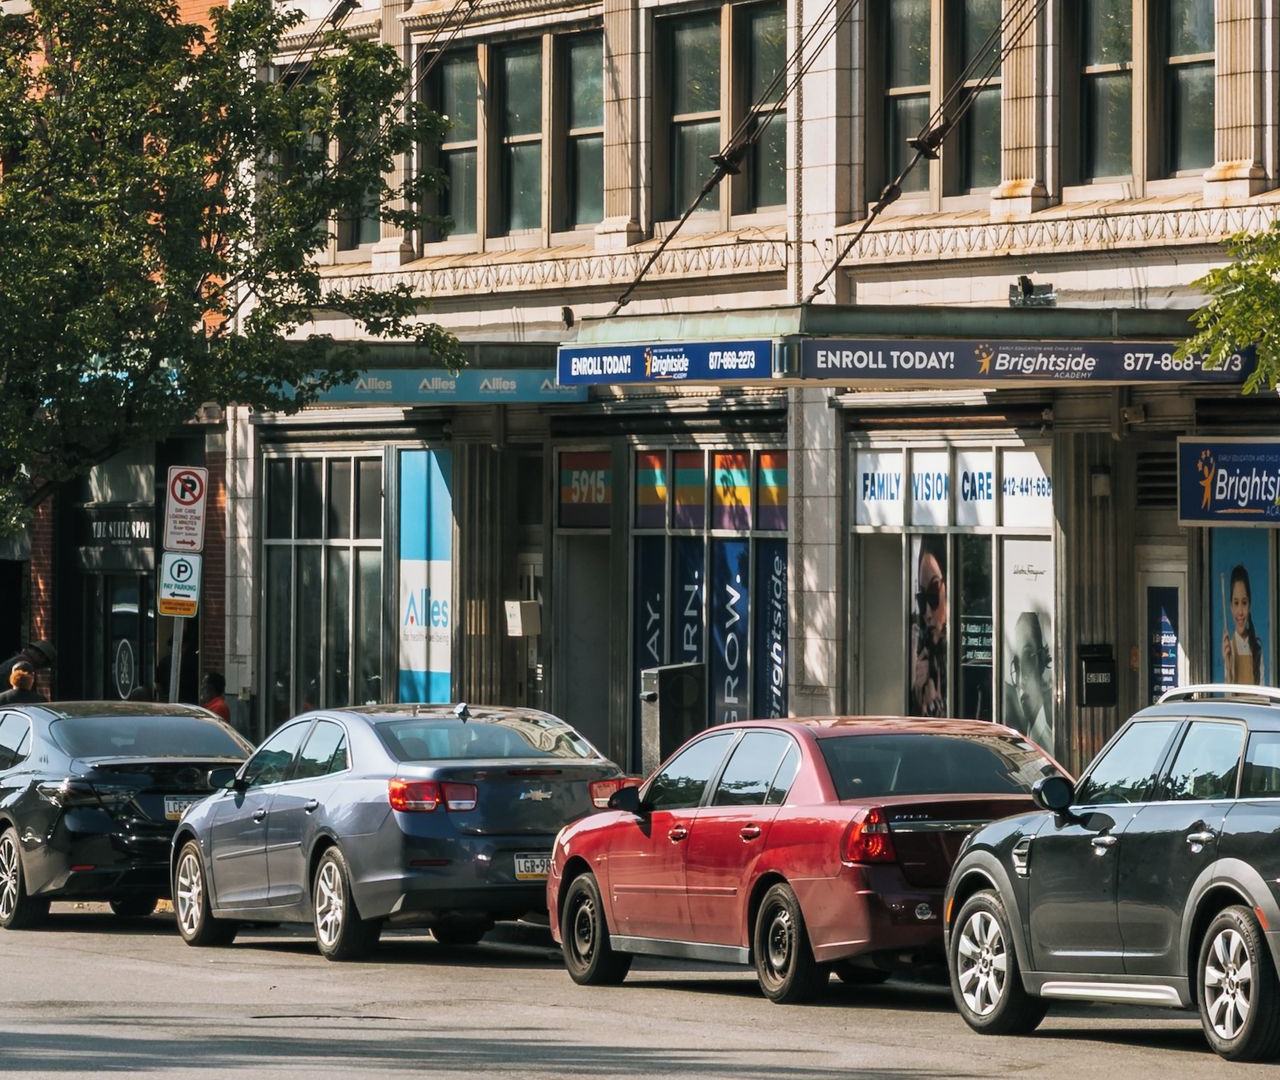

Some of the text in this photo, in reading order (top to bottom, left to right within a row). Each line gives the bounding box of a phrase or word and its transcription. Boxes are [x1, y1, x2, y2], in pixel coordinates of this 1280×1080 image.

[571, 355, 631, 375] ENROLL TODAY!
[651, 354, 690, 375] Brightside
[708, 350, 756, 370] 877-868-2273
[817, 350, 955, 369] ENROLL TODAY!
[995, 353, 1097, 374] Brightside
[1123, 353, 1242, 371] 877-868-273
[355, 377, 392, 390] Allies
[419, 377, 456, 390] Allies
[480, 377, 516, 390] Allies
[571, 470, 606, 504] 5915
[862, 472, 902, 501] FAMILY
[961, 471, 993, 501] CARE
[131, 521, 150, 539] SPOT
[174, 583, 197, 591] PARKING
[404, 588, 449, 628] Allies
[646, 592, 661, 661] AY.
